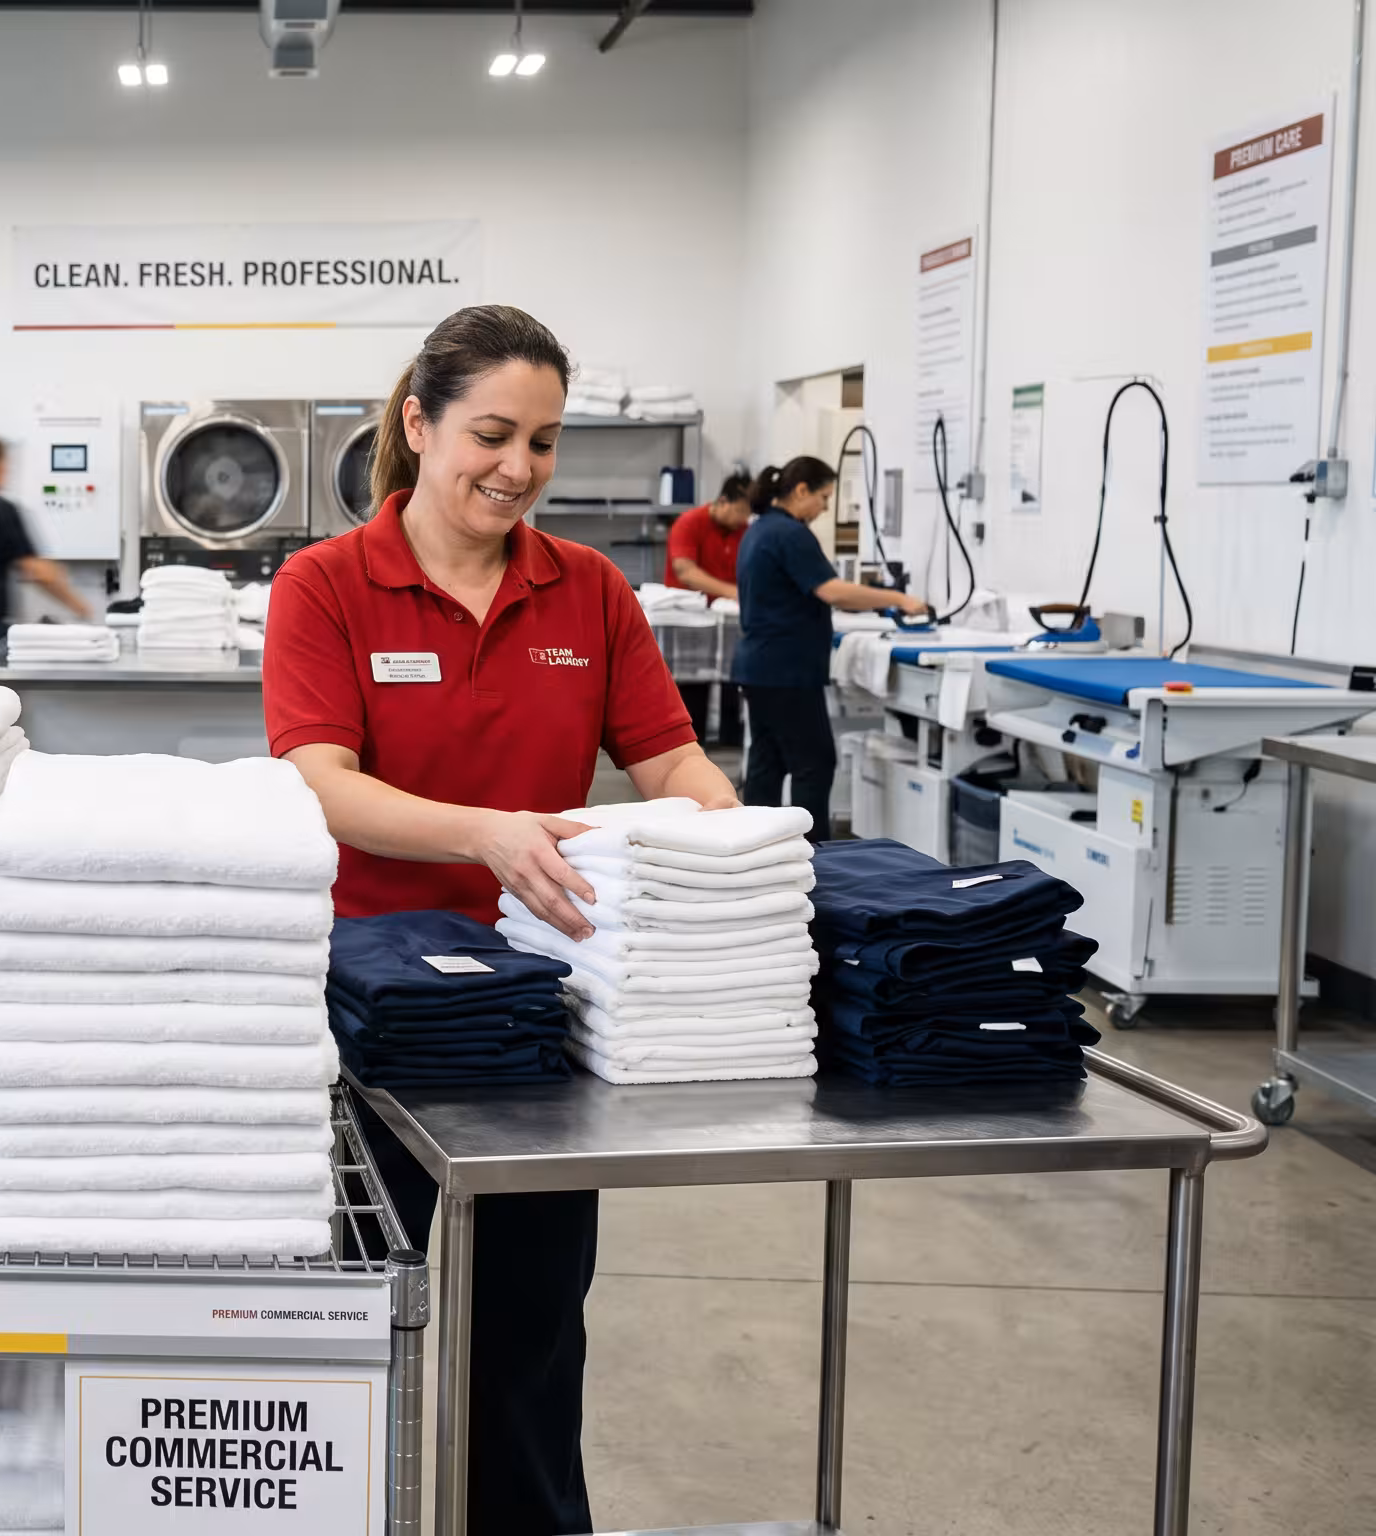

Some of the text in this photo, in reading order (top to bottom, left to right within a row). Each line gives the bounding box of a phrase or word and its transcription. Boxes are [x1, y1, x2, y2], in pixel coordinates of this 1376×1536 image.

[1275, 127, 1302, 154] CARE
[35, 259, 460, 288] CLEAN. FRESH. PROFESSIONAL.
[545, 648, 573, 657] TEAM
[212, 1309, 369, 1321] PREMIUM COMMERCIAL SERVICE
[141, 1398, 308, 1432] PREMIUM
[105, 1436, 344, 1472] COMMERCIAL
[150, 1476, 297, 1510] SERVICE
